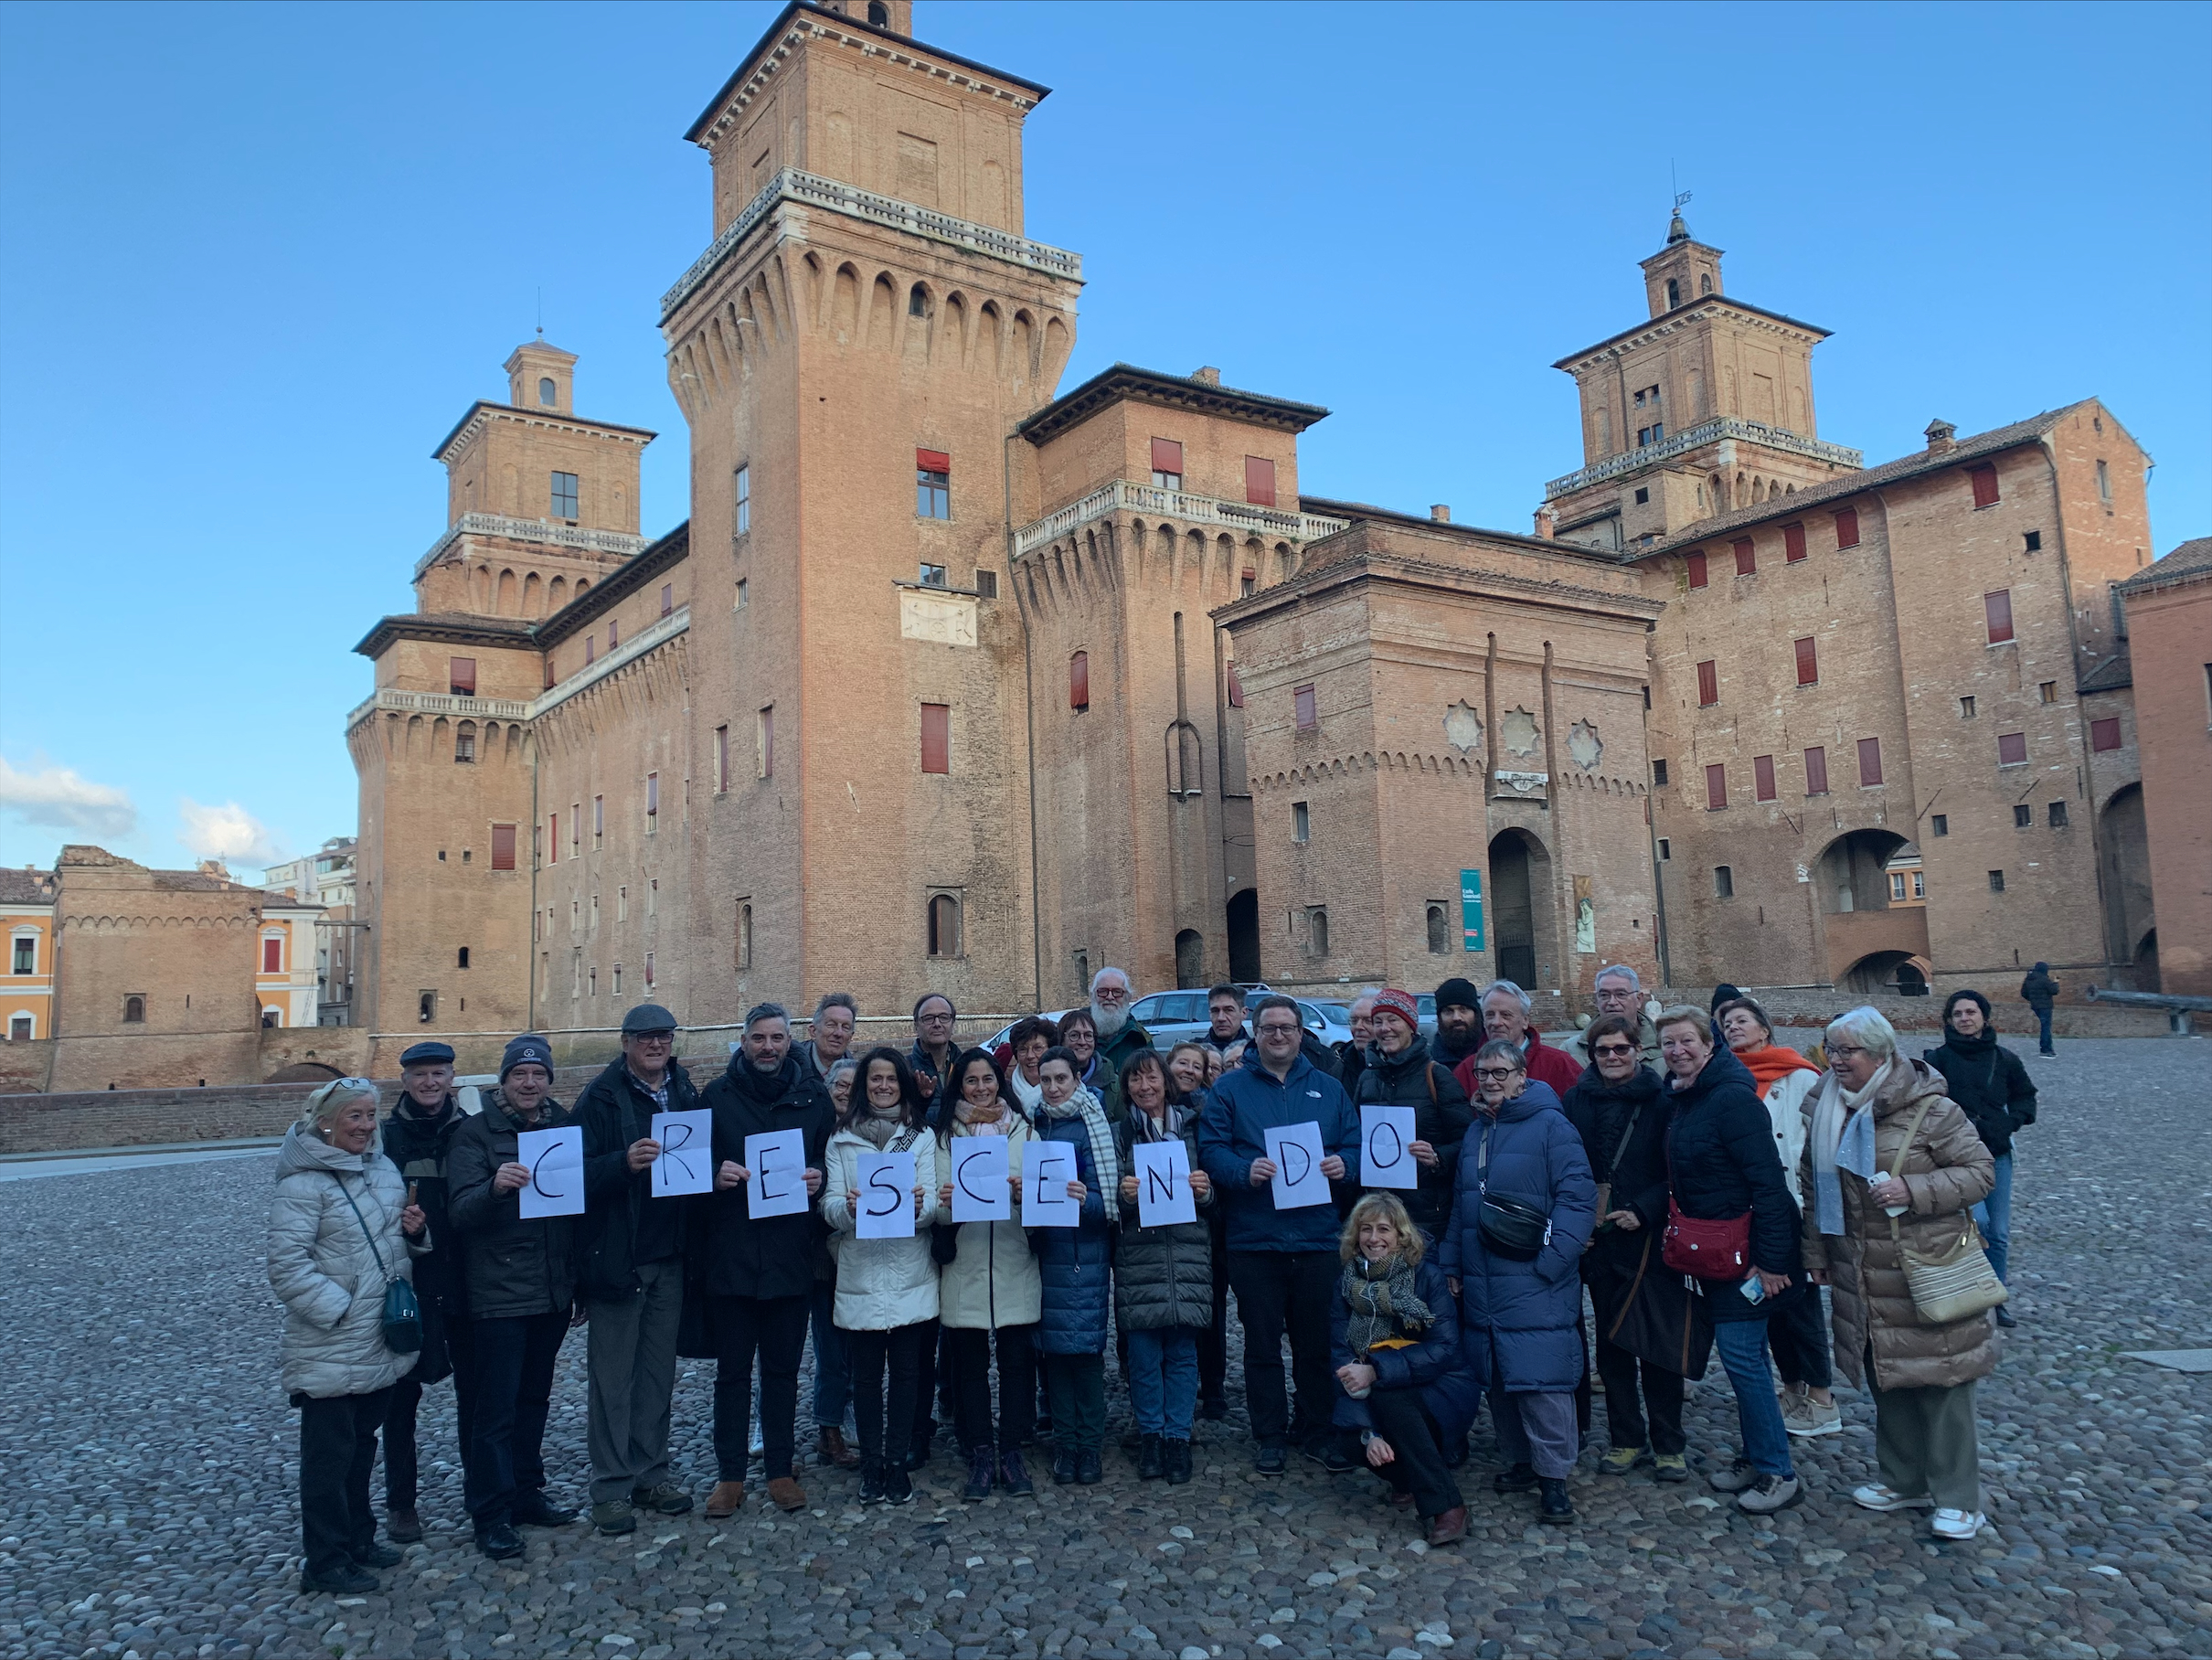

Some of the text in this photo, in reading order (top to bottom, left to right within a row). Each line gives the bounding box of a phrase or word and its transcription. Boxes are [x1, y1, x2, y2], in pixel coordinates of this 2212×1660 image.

[532, 1142, 564, 1197] C
[662, 1123, 695, 1186] R
[1279, 1141, 1311, 1186] D
[1369, 1122, 1401, 1169] O
[759, 1145, 790, 1200] E
[866, 1165, 901, 1216] S
[957, 1151, 994, 1204] C
[1037, 1158, 1065, 1204] E
[1146, 1156, 1174, 1204] N
